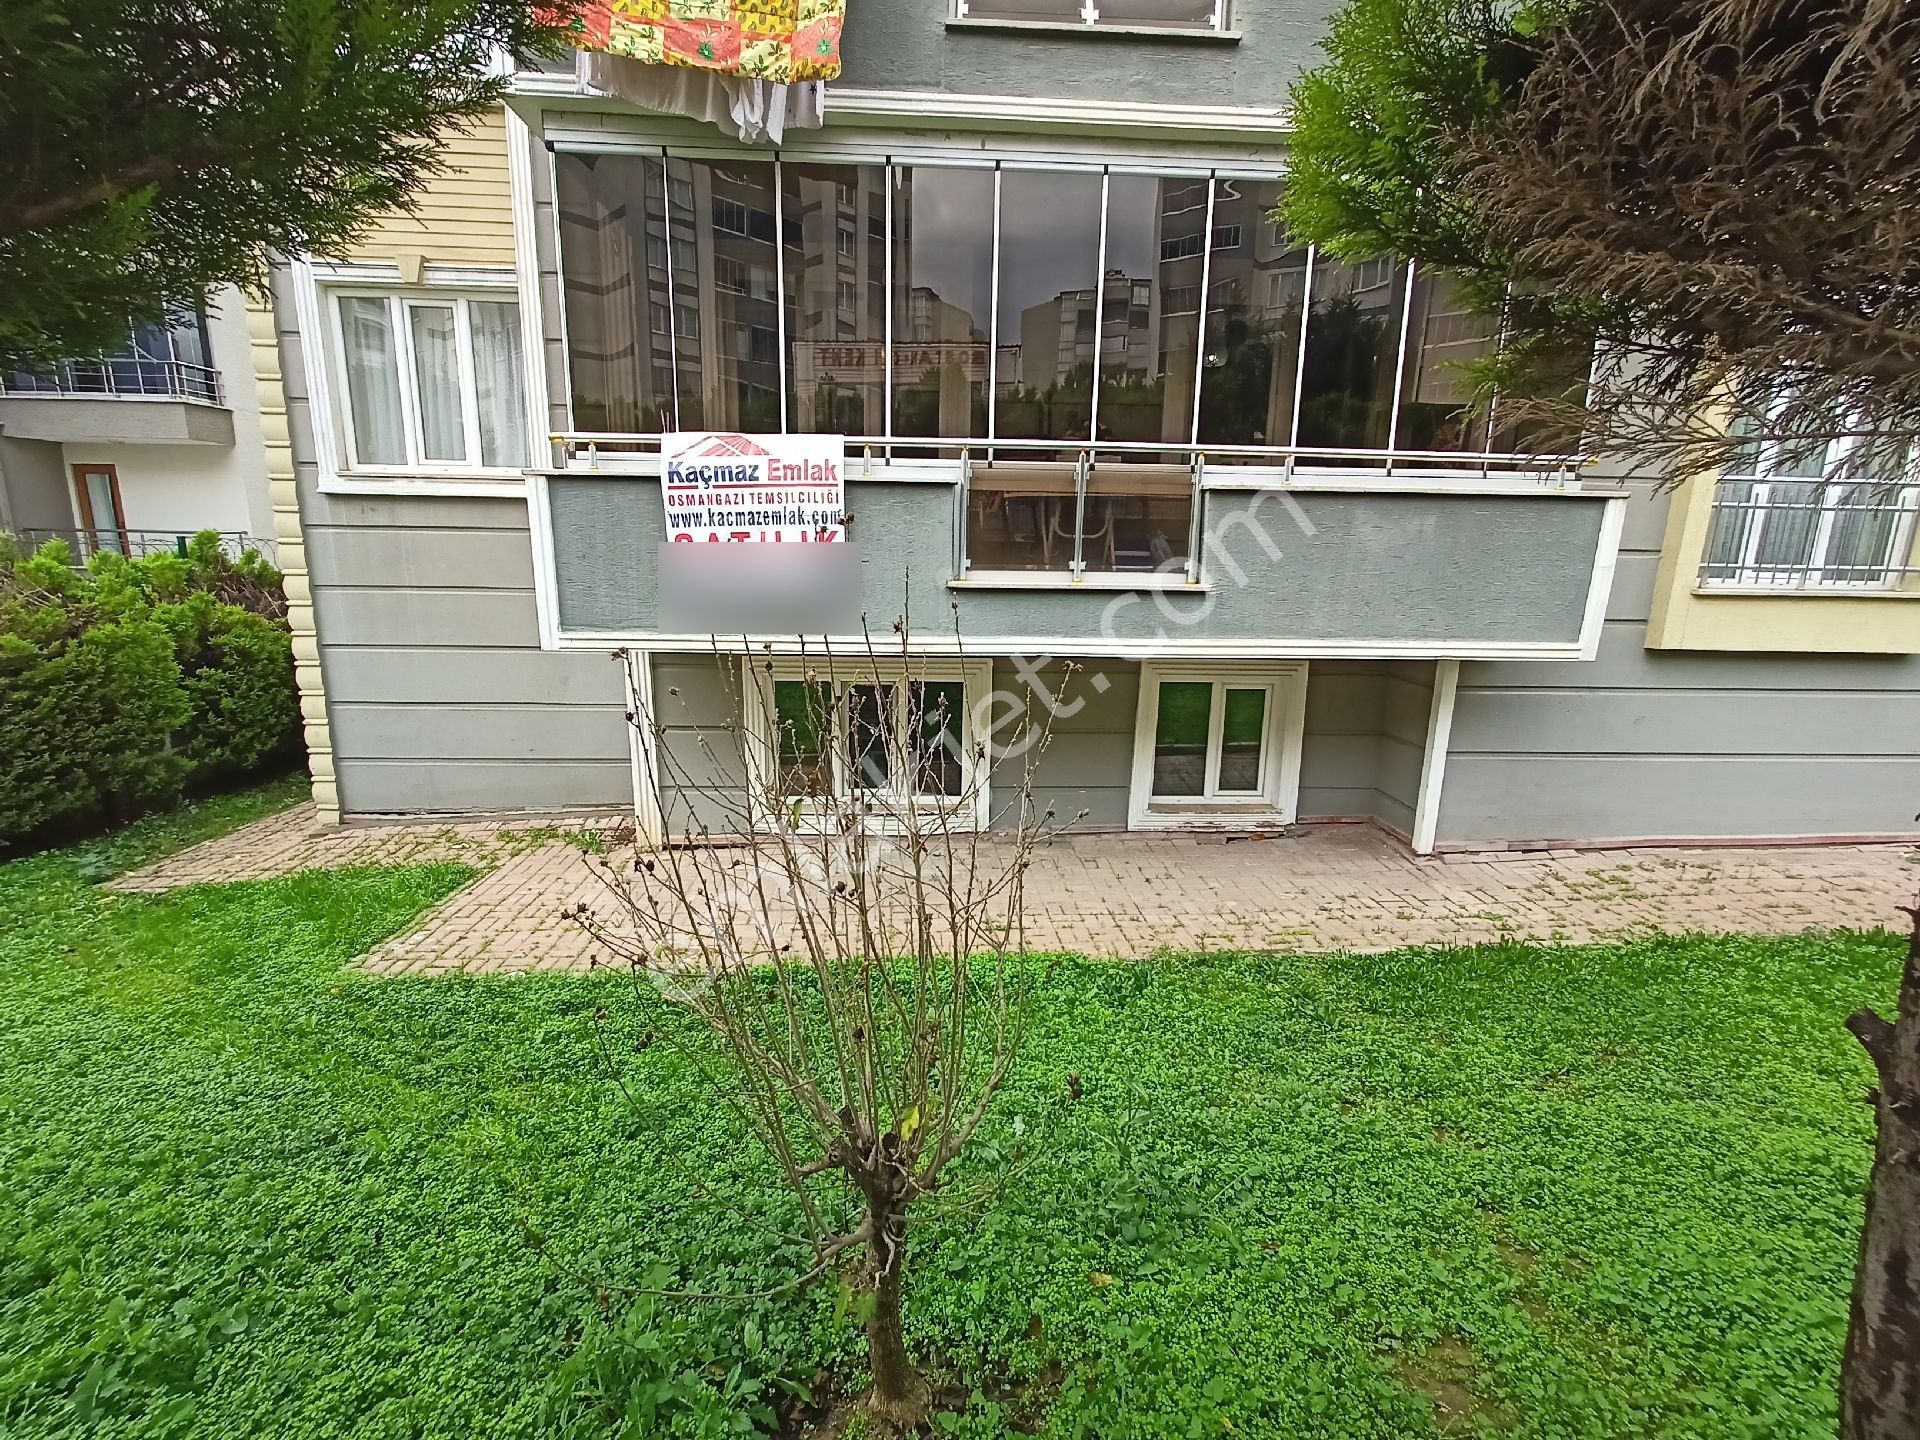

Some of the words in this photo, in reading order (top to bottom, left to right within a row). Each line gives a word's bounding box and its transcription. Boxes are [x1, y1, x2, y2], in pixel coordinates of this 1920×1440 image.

[668, 461, 760, 490] Kaçmaz
[767, 458, 839, 482] Emlak
[668, 491, 745, 507] OSMANGAZİ
[668, 505, 841, 528] www.kacmazemlak.com
